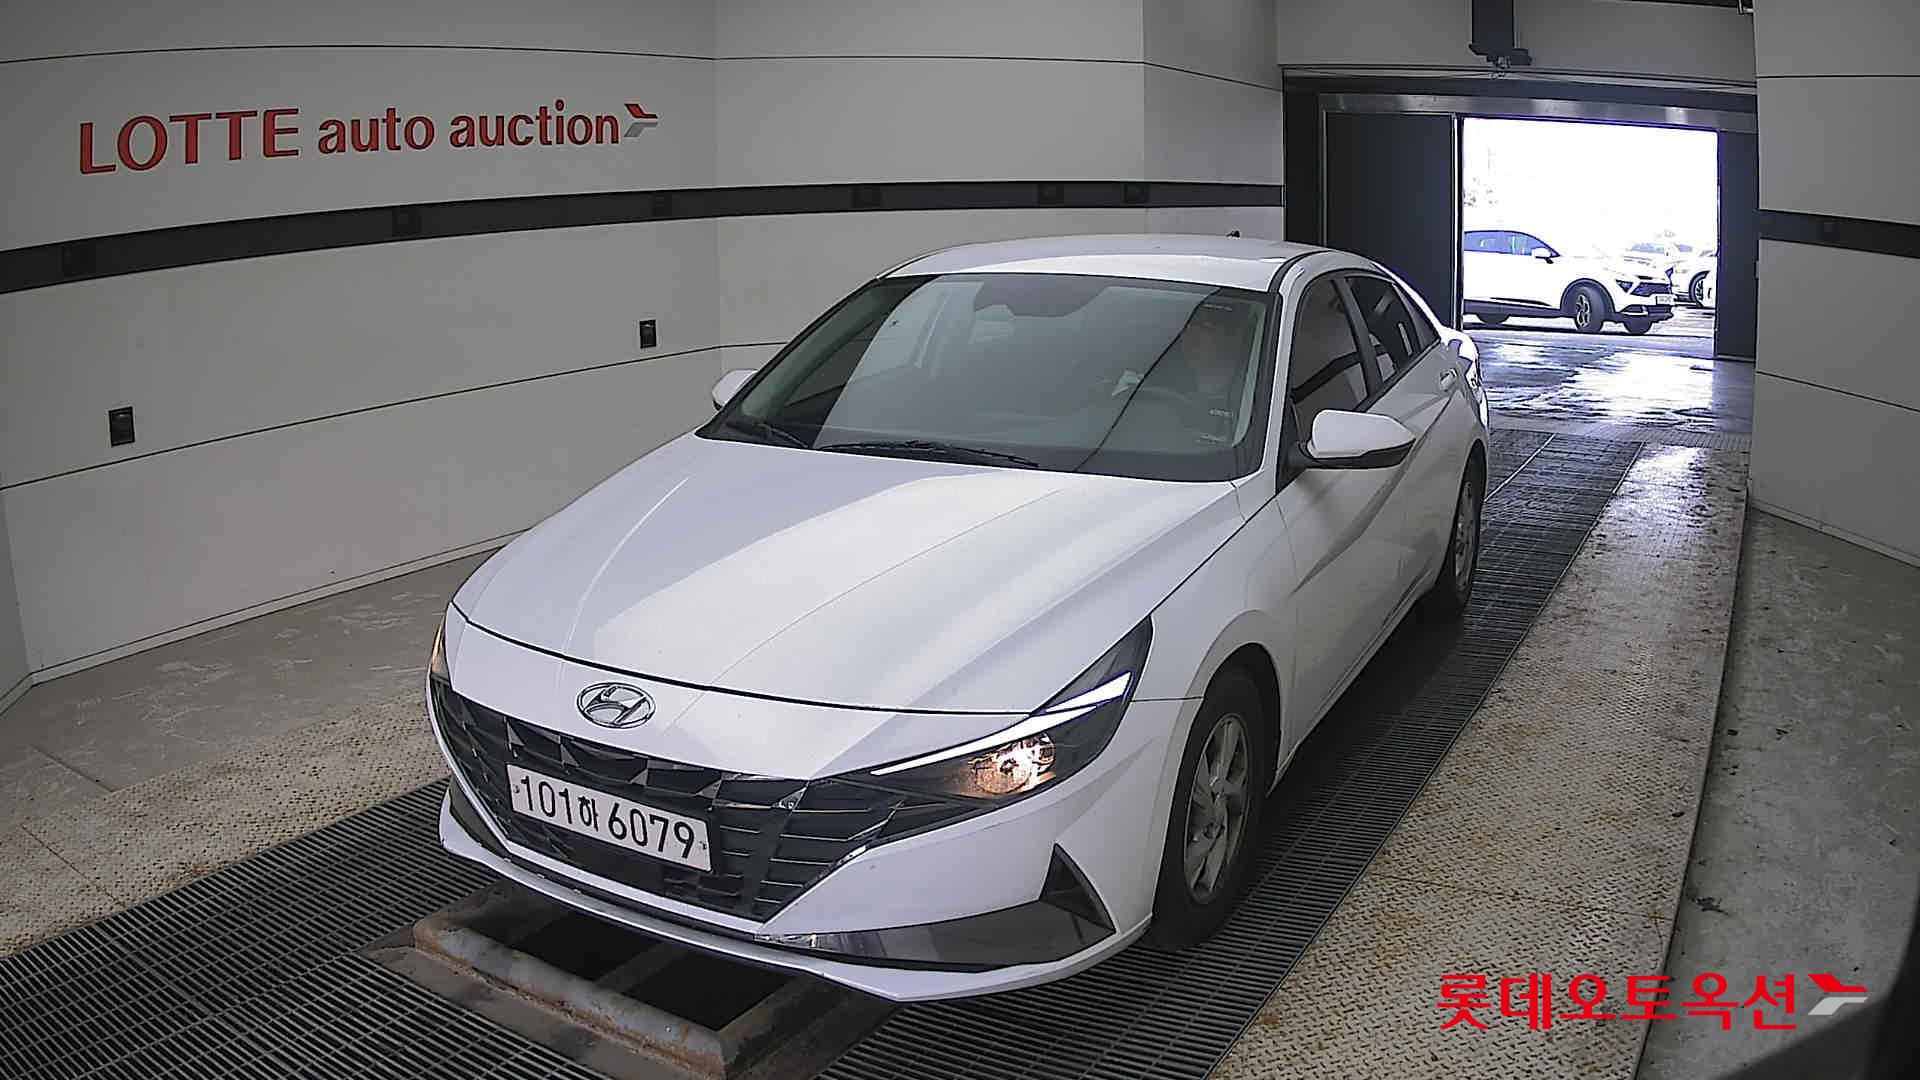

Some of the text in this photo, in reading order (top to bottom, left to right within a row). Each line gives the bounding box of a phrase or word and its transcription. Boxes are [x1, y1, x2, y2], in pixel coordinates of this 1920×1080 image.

[79, 99, 621, 175] LOTTE auto auction
[607, 802, 695, 859] 6079
